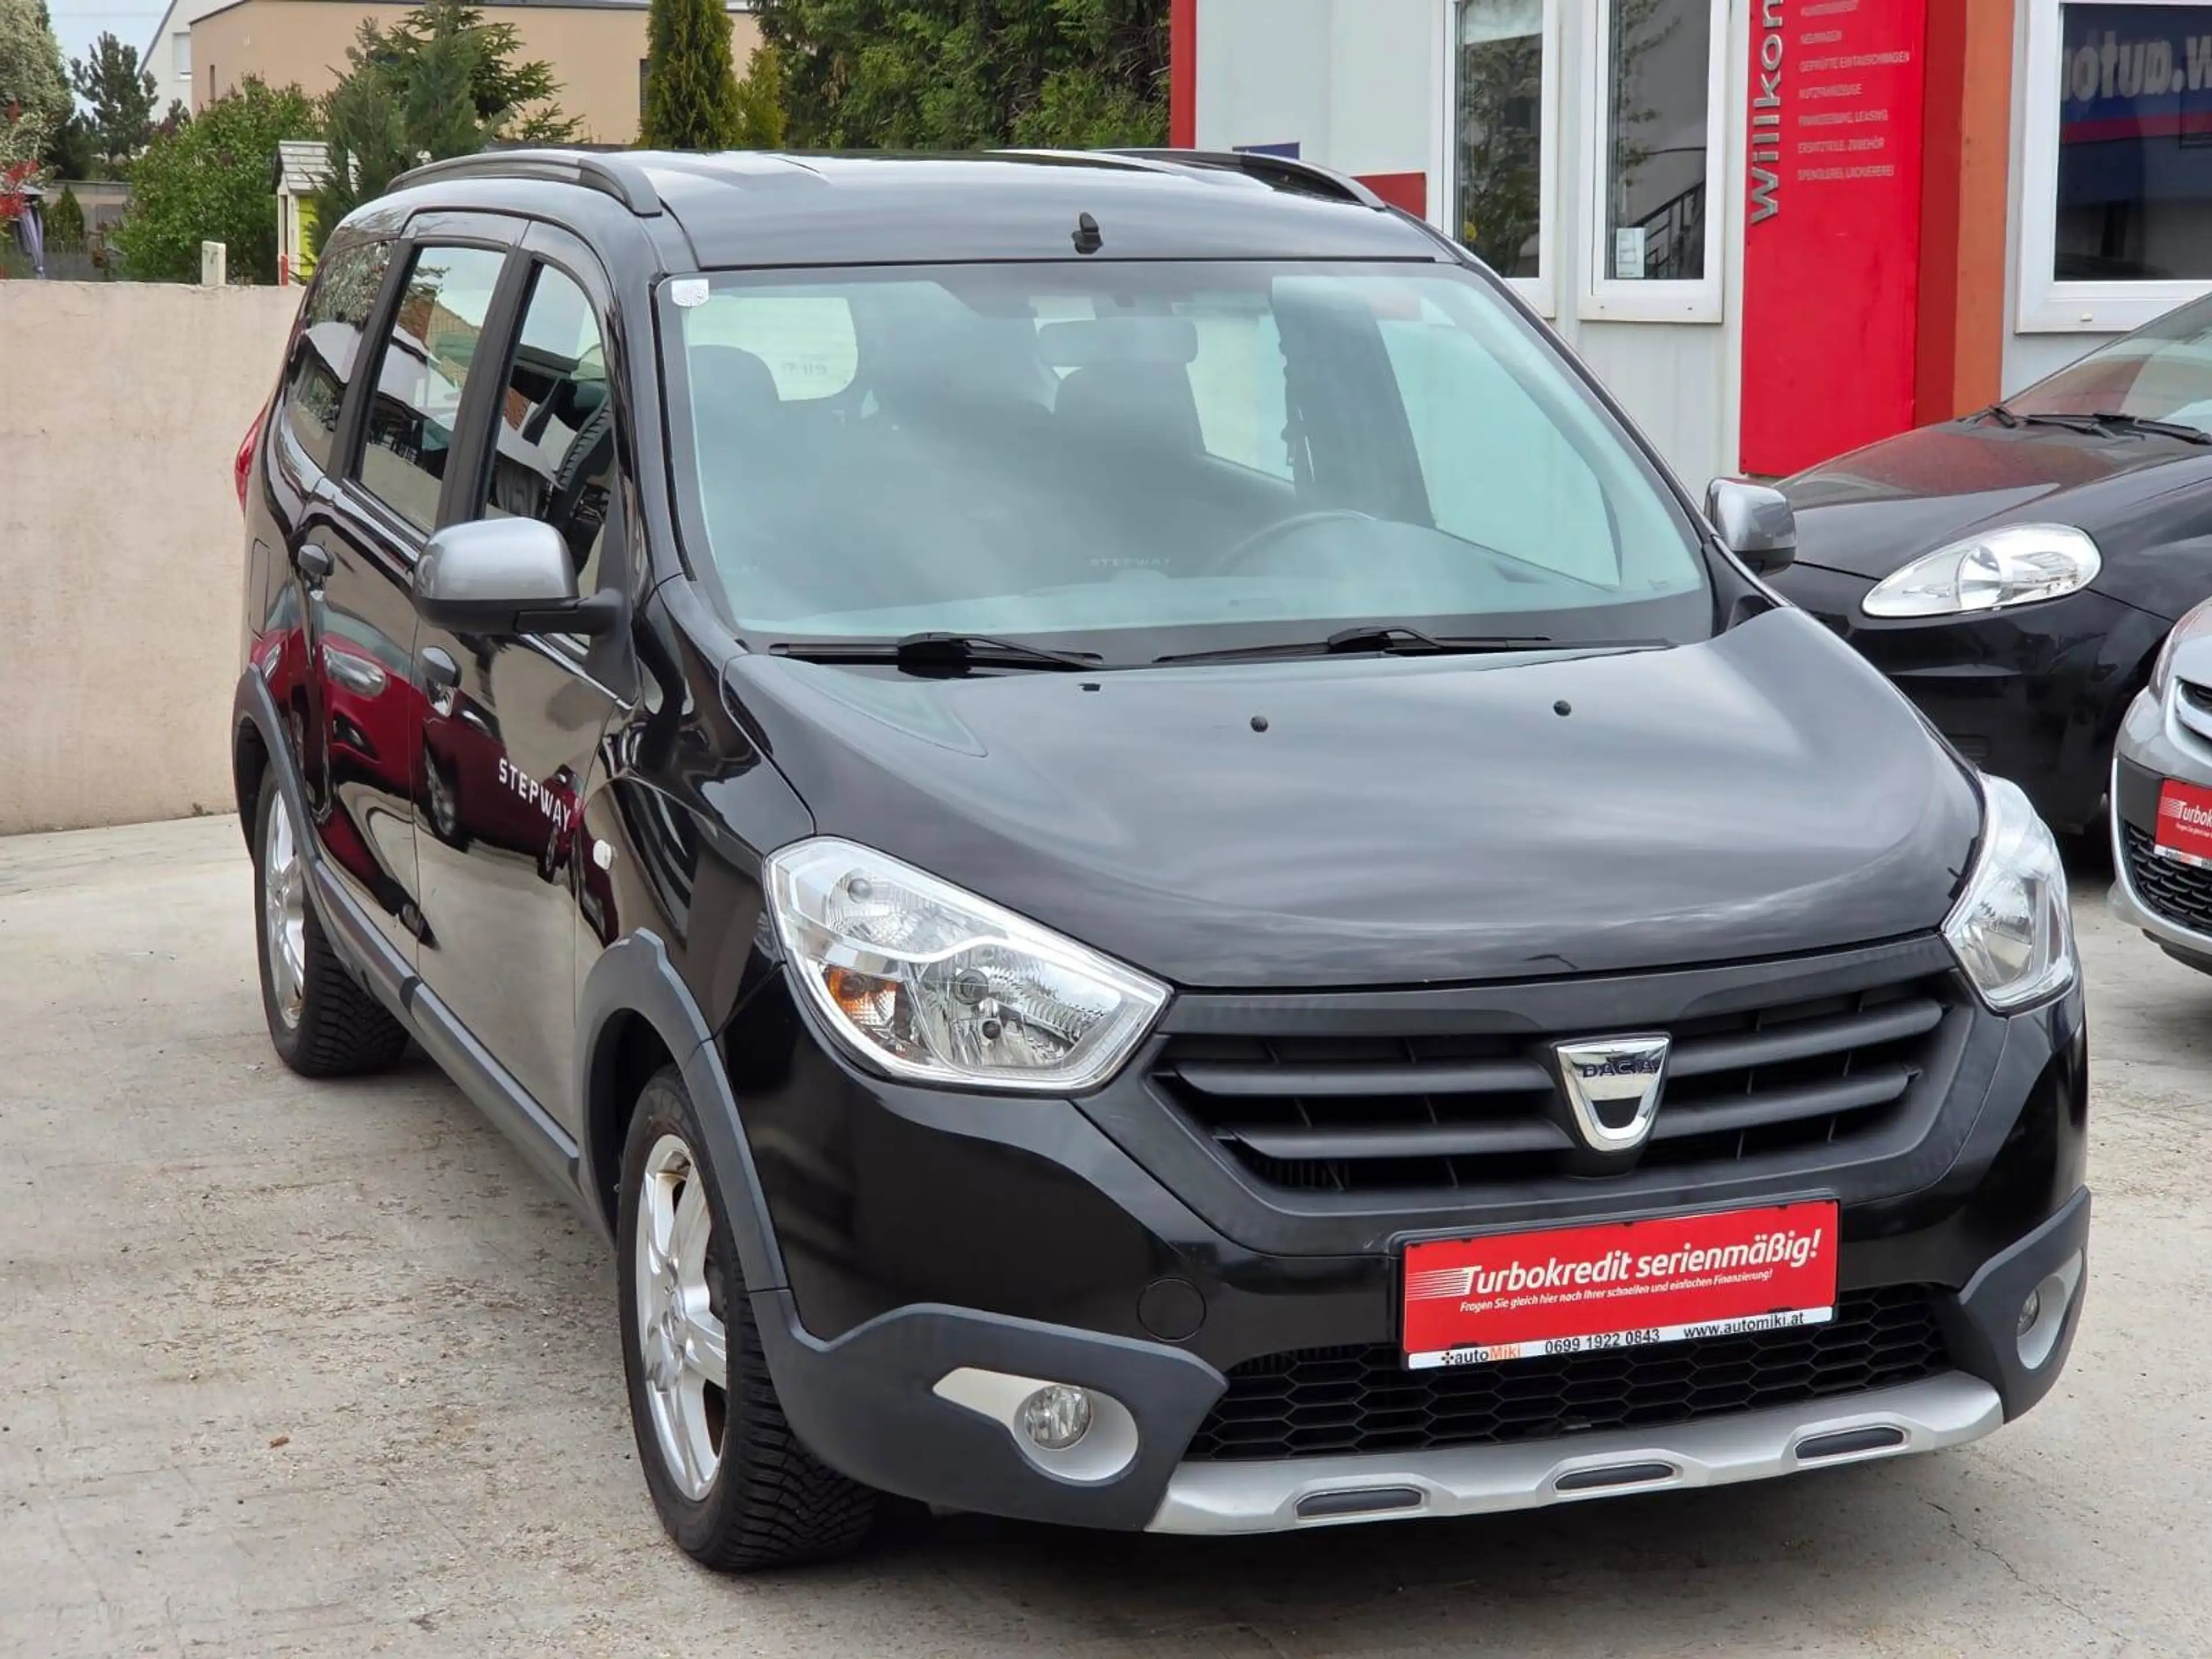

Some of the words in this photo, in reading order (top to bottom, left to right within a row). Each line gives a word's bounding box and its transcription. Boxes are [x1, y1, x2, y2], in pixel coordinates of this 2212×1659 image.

[499, 758, 571, 832] STEPWAY
[1583, 1059, 1661, 1077] DACIA
[1462, 1250, 1632, 1295] Turbokredit
[1635, 1228, 1821, 1278] serienmäßig!
[1460, 1302, 1492, 1313] Fragen
[1494, 1298, 1508, 1309] Sie
[1510, 1296, 1538, 1309] gleich
[1540, 1294, 1557, 1304] hier
[1651, 1282, 1668, 1293] und
[1670, 1277, 1712, 1290] einfachen
[1713, 1268, 1773, 1285] Finanzierung!
[1455, 1343, 1521, 1365] autoMiki
[1545, 1338, 1580, 1354] 0699
[1586, 1332, 1620, 1349] 1922
[1626, 1328, 1660, 1344] 0843
[1683, 1312, 1804, 1338] www.automiki.at
